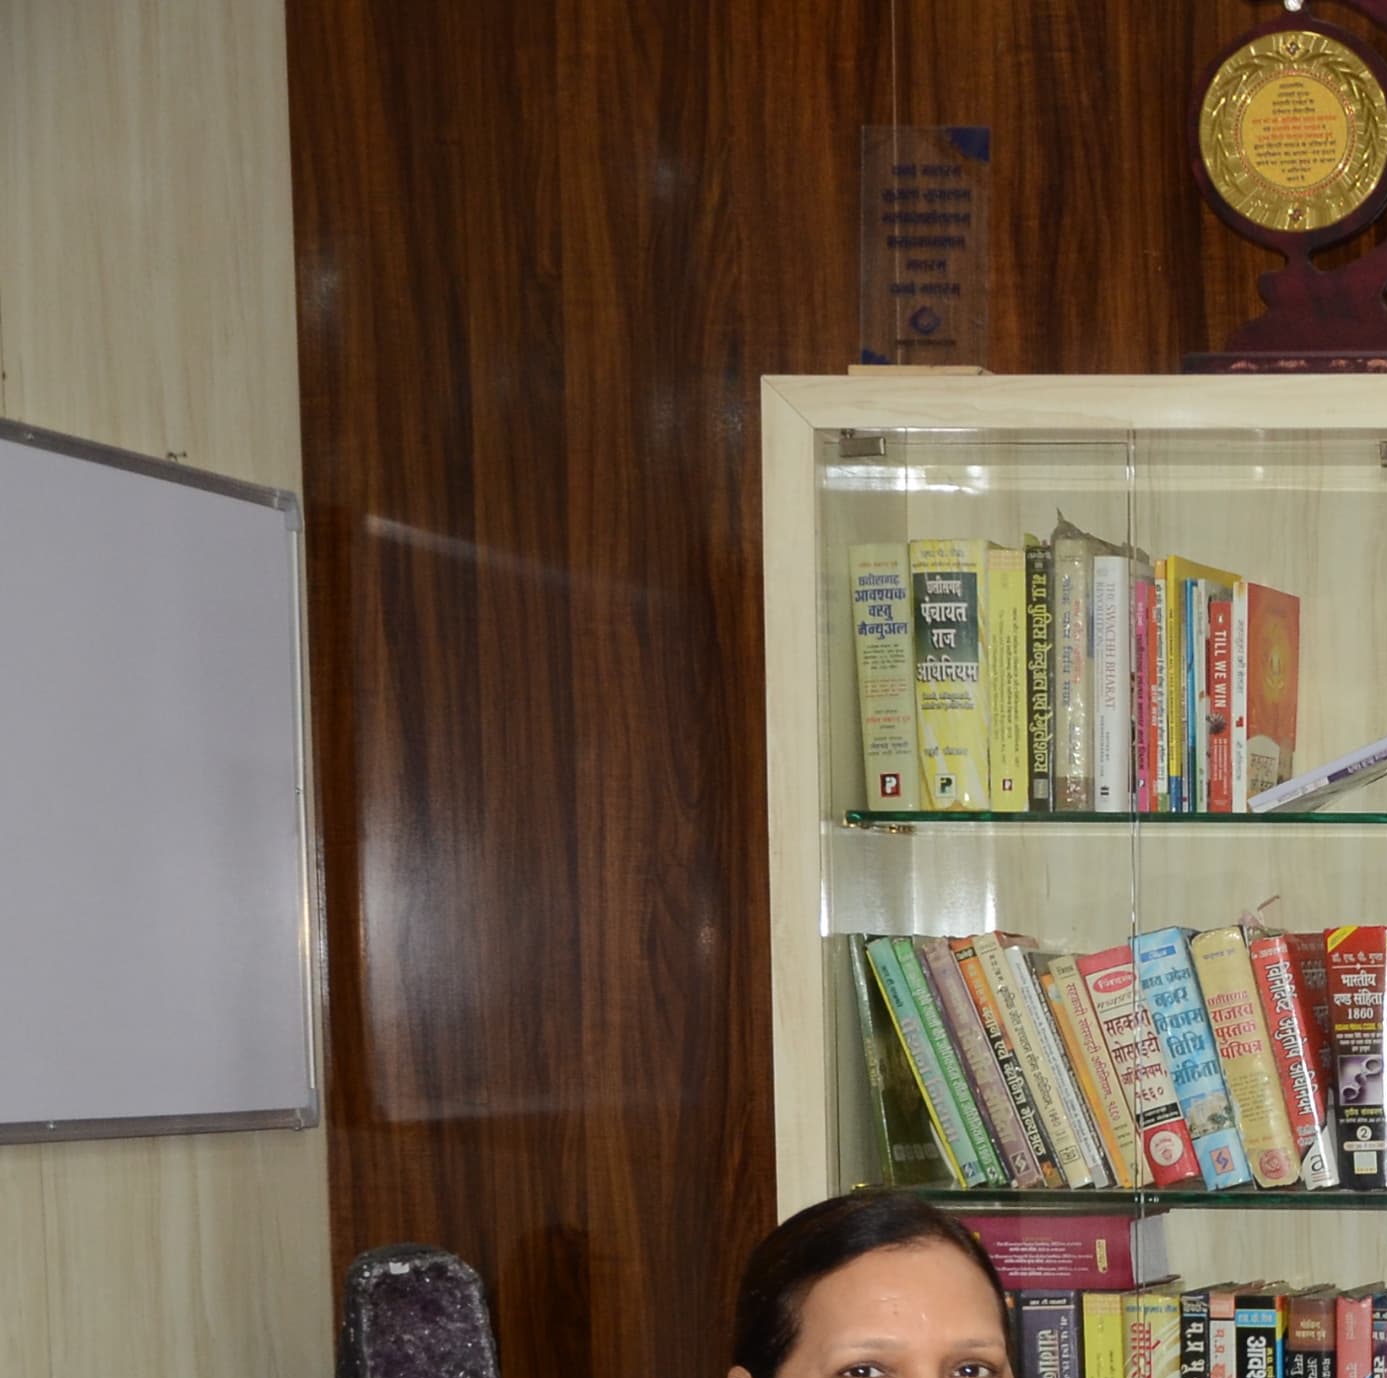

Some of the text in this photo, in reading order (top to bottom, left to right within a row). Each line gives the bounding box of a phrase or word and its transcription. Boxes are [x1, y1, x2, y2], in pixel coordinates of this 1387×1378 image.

[854, 587, 906, 603] आवश्यक
[920, 596, 969, 623] पंचायत
[1027, 603, 1052, 639] पुलिस
[931, 628, 957, 649] राज
[1104, 604, 1117, 657] SWACHH
[916, 654, 979, 682] अधिनियम
[1214, 631, 1227, 708] TILL WE WIN
[1104, 661, 1116, 710] BHARAT
[1341, 969, 1377, 988] भारतीय
[1333, 988, 1385, 1007] दण्ड संहिता
[1103, 1007, 1152, 1037] सहकारी
[1210, 1003, 1254, 1023] राजस्व
[1346, 1007, 1374, 1020] 1860
[1215, 1021, 1257, 1045] पुस्तक
[1111, 1031, 1160, 1063] सोसाइटी
